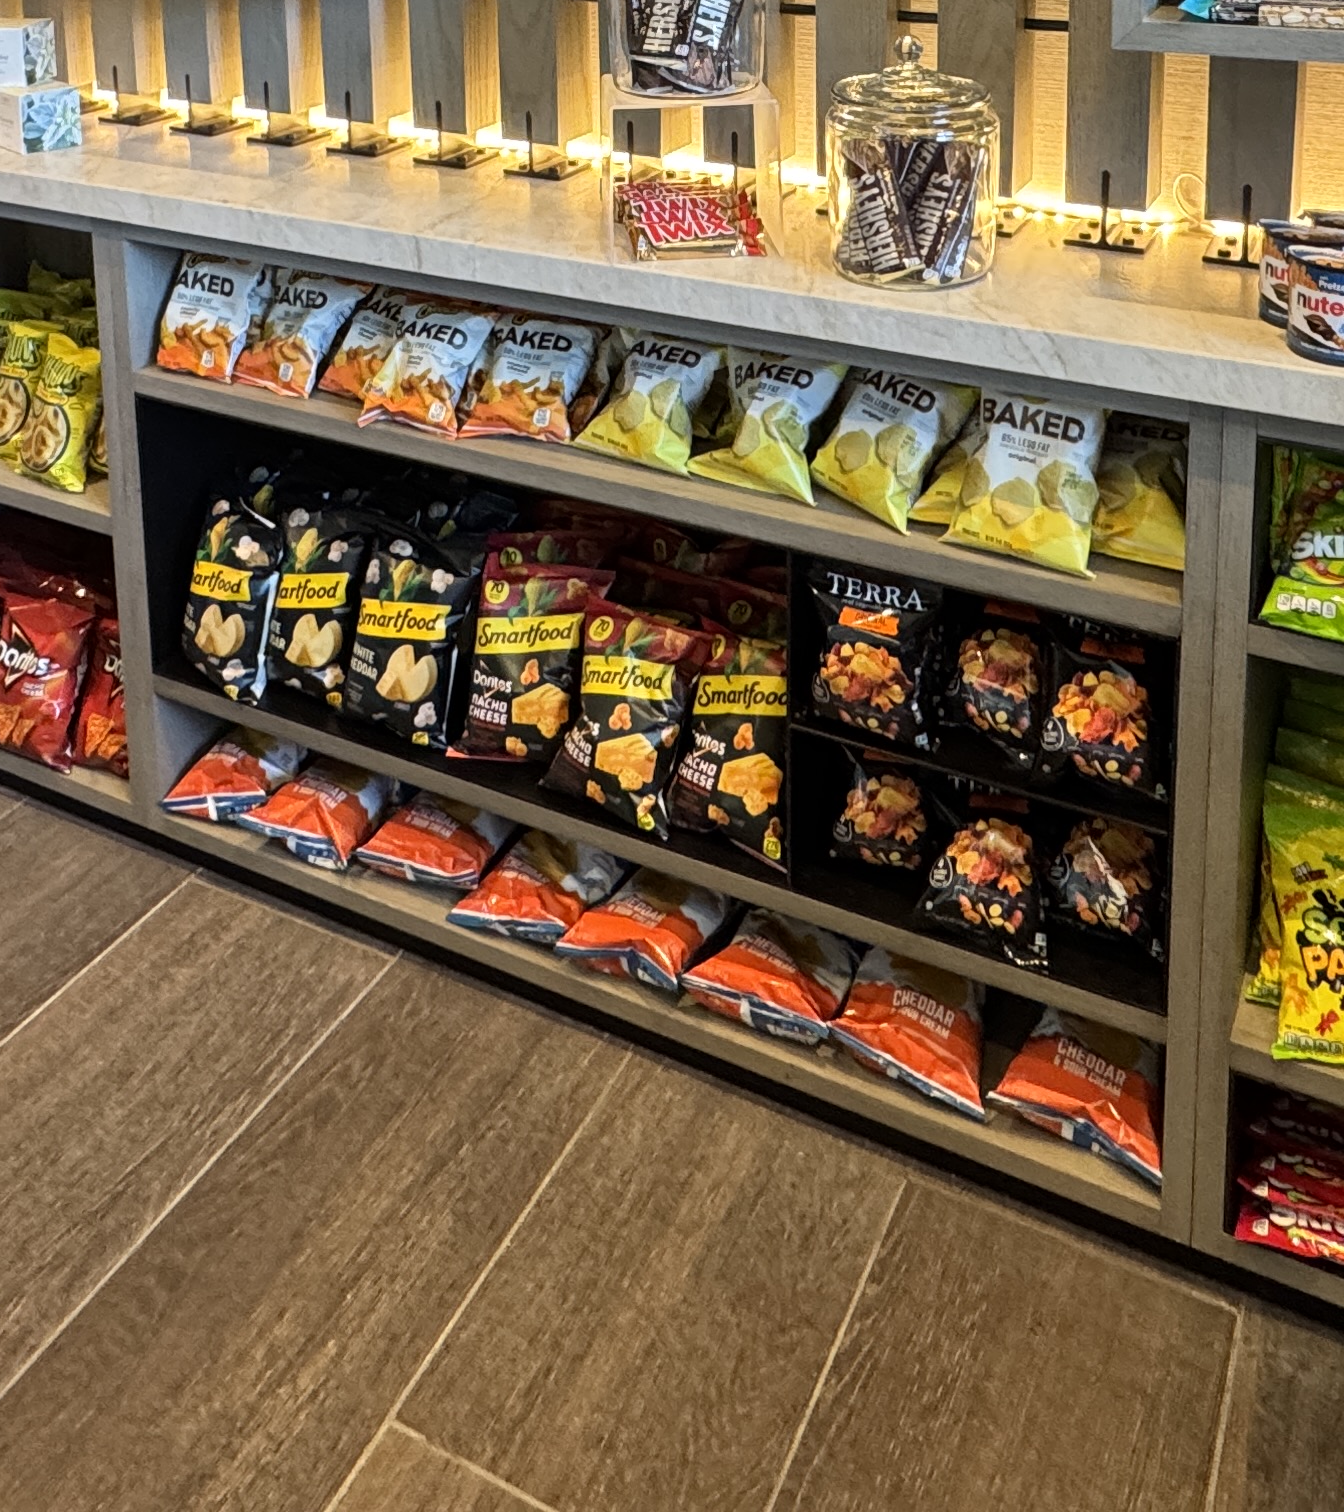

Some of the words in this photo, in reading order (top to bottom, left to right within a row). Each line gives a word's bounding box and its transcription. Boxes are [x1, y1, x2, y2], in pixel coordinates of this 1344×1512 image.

[636, 218, 735, 246] TWIX
[177, 269, 235, 298] AKED
[497, 326, 574, 353] AKED
[630, 339, 702, 369] AKED
[734, 360, 814, 390] BAKED
[861, 407, 885, 423] original
[983, 398, 1086, 445] BAKED
[1017, 436, 1035, 452] LESS
[1037, 441, 1052, 453] FAT
[1108, 422, 1185, 442] AKED
[1008, 452, 1038, 465] original
[191, 568, 242, 596] artfood
[279, 581, 340, 604] artfood
[490, 581, 505, 594] 70
[827, 571, 924, 612] TERRA
[358, 604, 439, 634] Smartfood
[595, 619, 611, 632] 70
[478, 620, 576, 648] Smartfood
[473, 669, 512, 694] Doritos
[582, 661, 665, 691] Smartfood
[471, 692, 507, 711] NACHO
[468, 707, 507, 726] CHEESE
[692, 729, 727, 757] oritos
[892, 989, 955, 1027] CHEDDAR
[920, 1013, 951, 1039] CREAM
[1057, 1037, 1127, 1087] CHEDDAR
[1062, 1058, 1087, 1079] SOUR
[1088, 1071, 1122, 1097] CREAM
